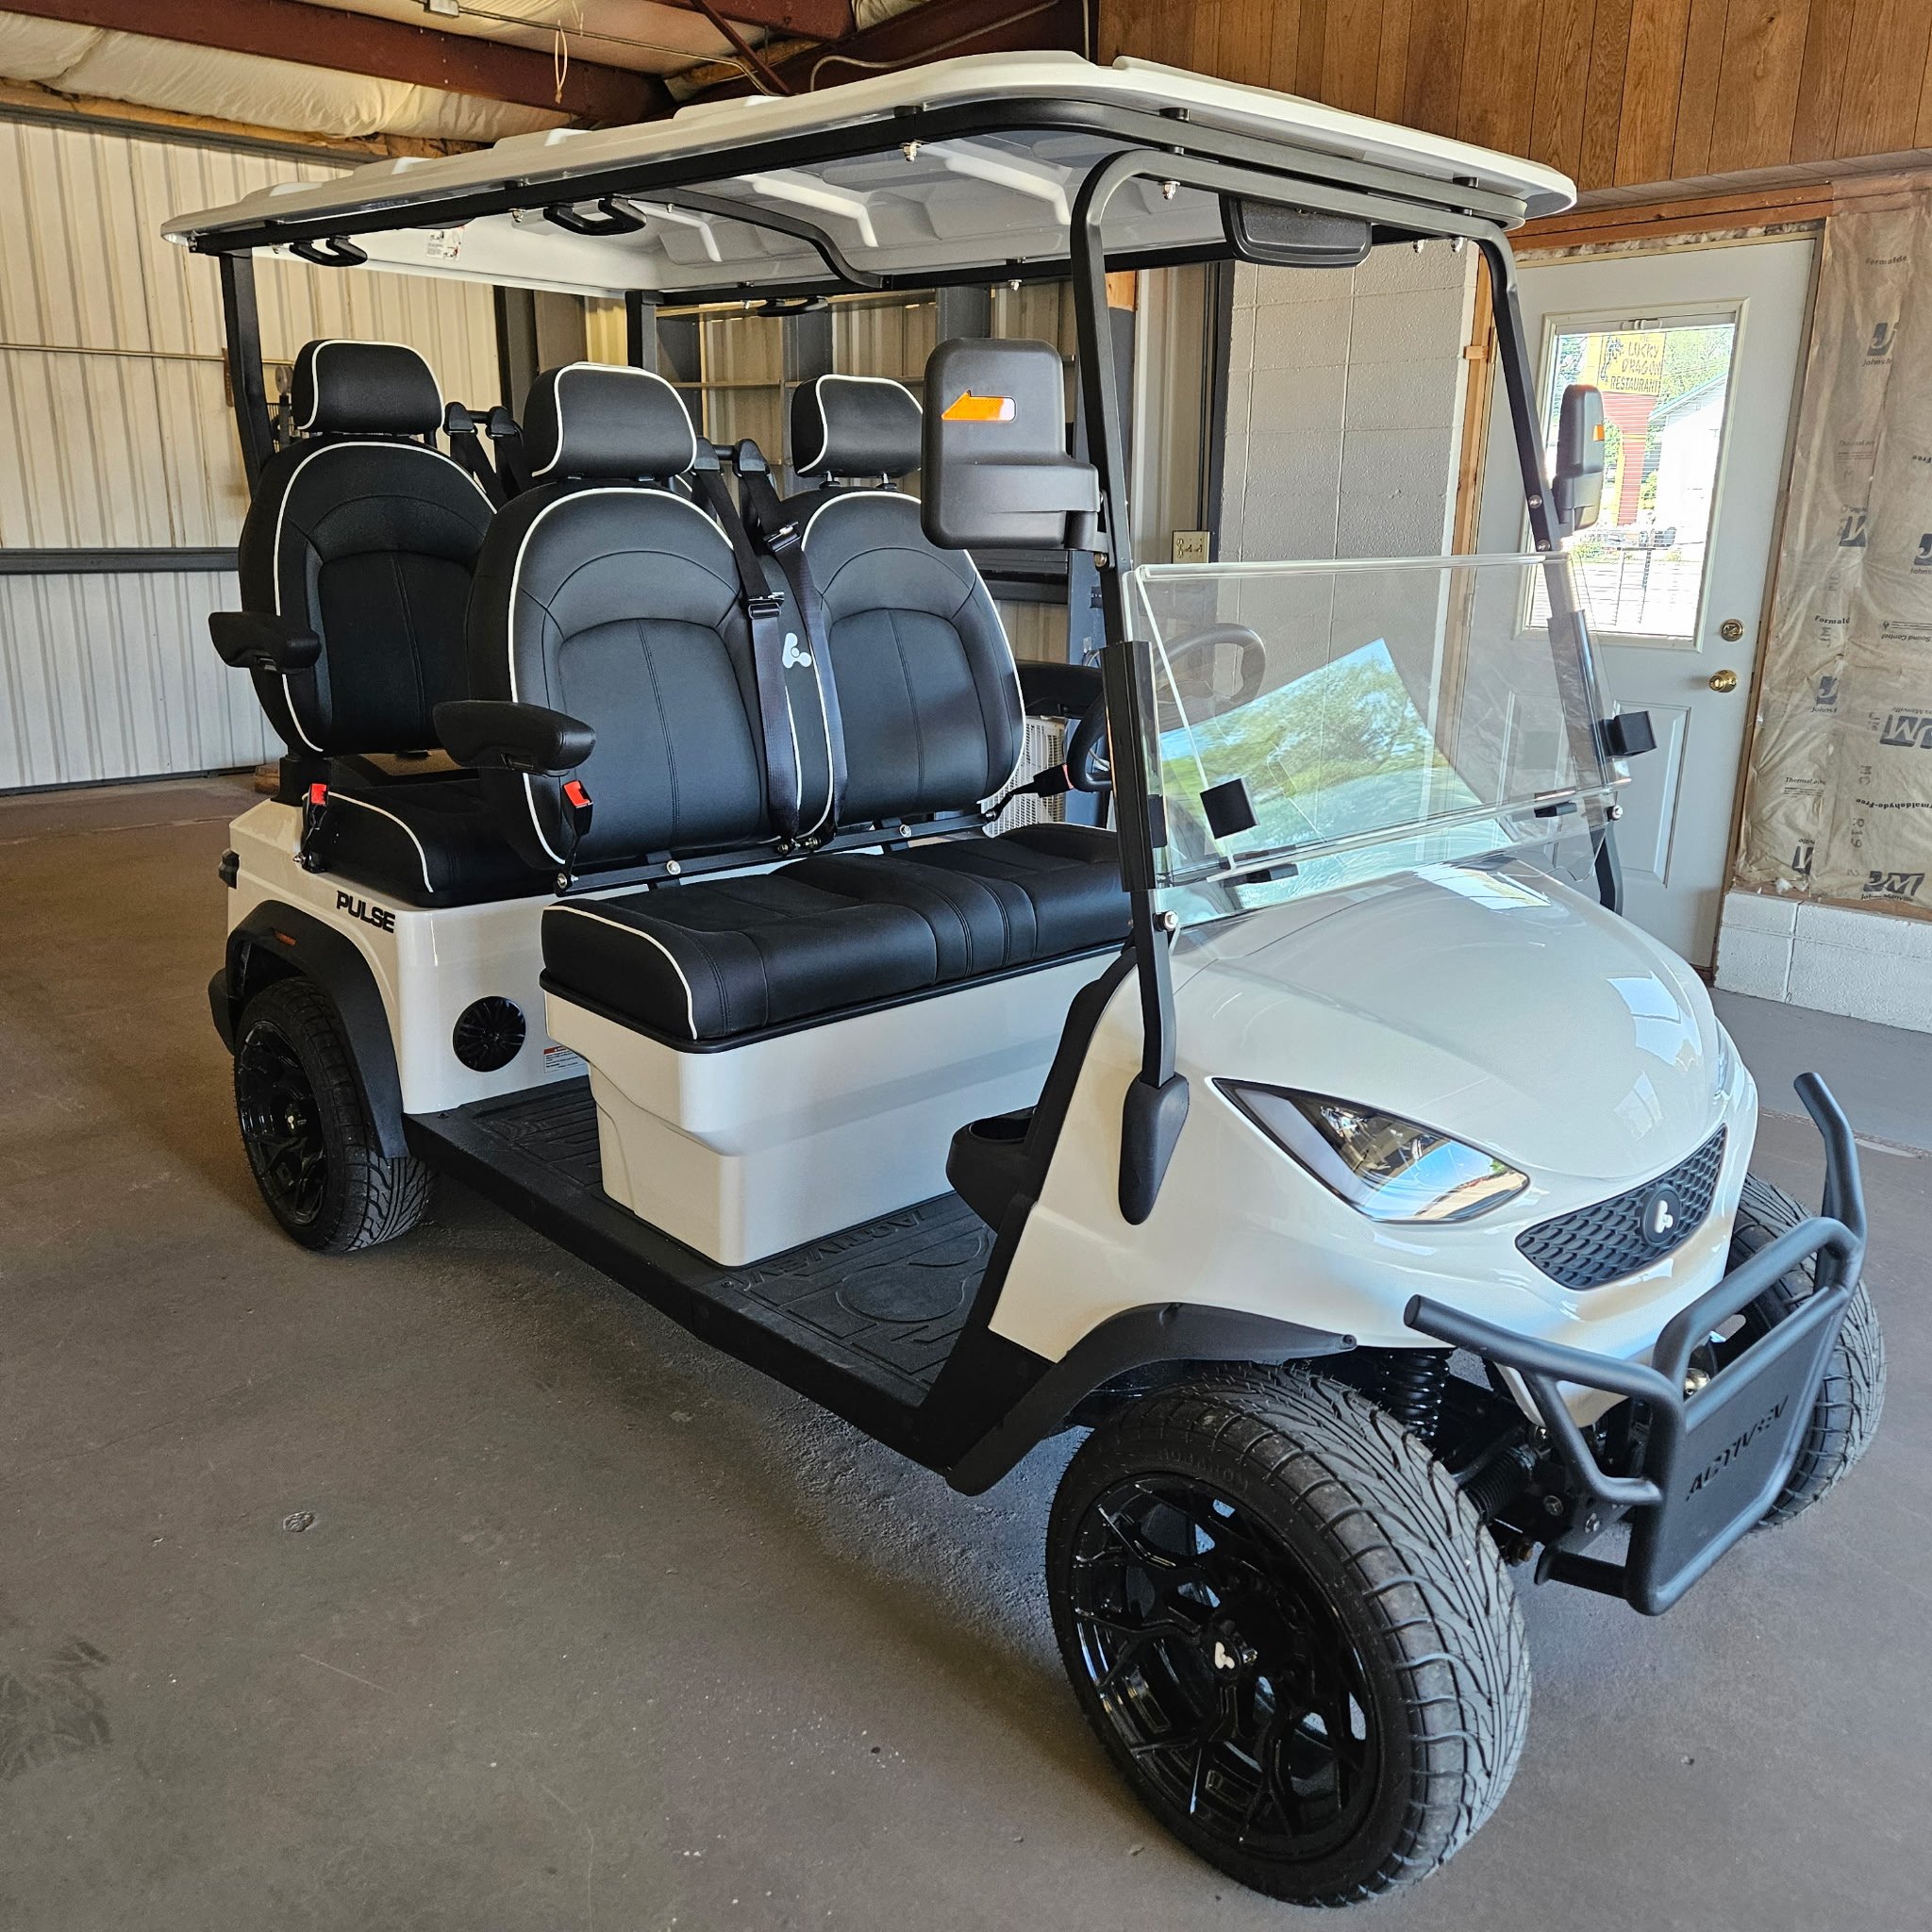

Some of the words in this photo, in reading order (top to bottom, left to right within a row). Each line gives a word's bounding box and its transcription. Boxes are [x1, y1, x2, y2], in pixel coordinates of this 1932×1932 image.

[1628, 341, 1659, 358] LUCKY
[1610, 375, 1659, 392] RESTAURANT
[336, 890, 396, 934] PULSE
